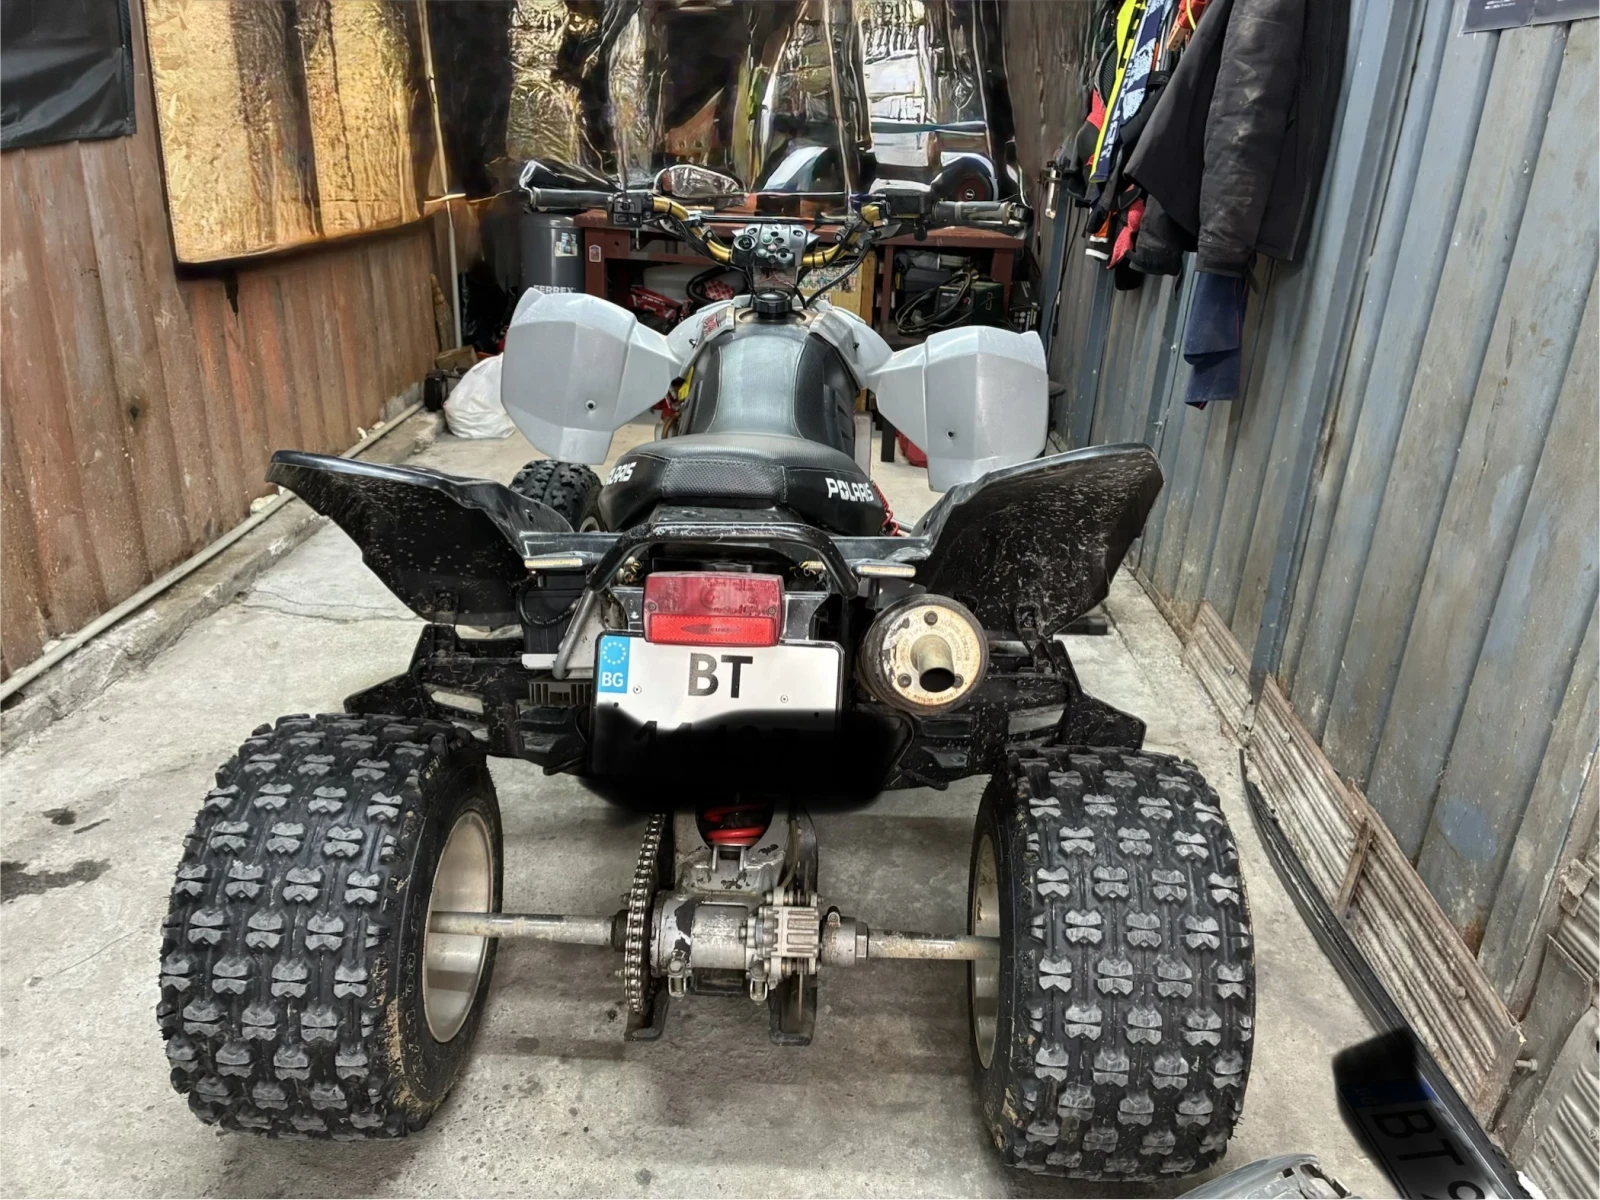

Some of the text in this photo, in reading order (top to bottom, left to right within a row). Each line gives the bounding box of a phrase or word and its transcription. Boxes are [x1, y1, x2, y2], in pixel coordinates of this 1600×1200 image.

[825, 478, 874, 502] POLARIS
[601, 672, 624, 687] BG
[688, 652, 753, 699] BT
